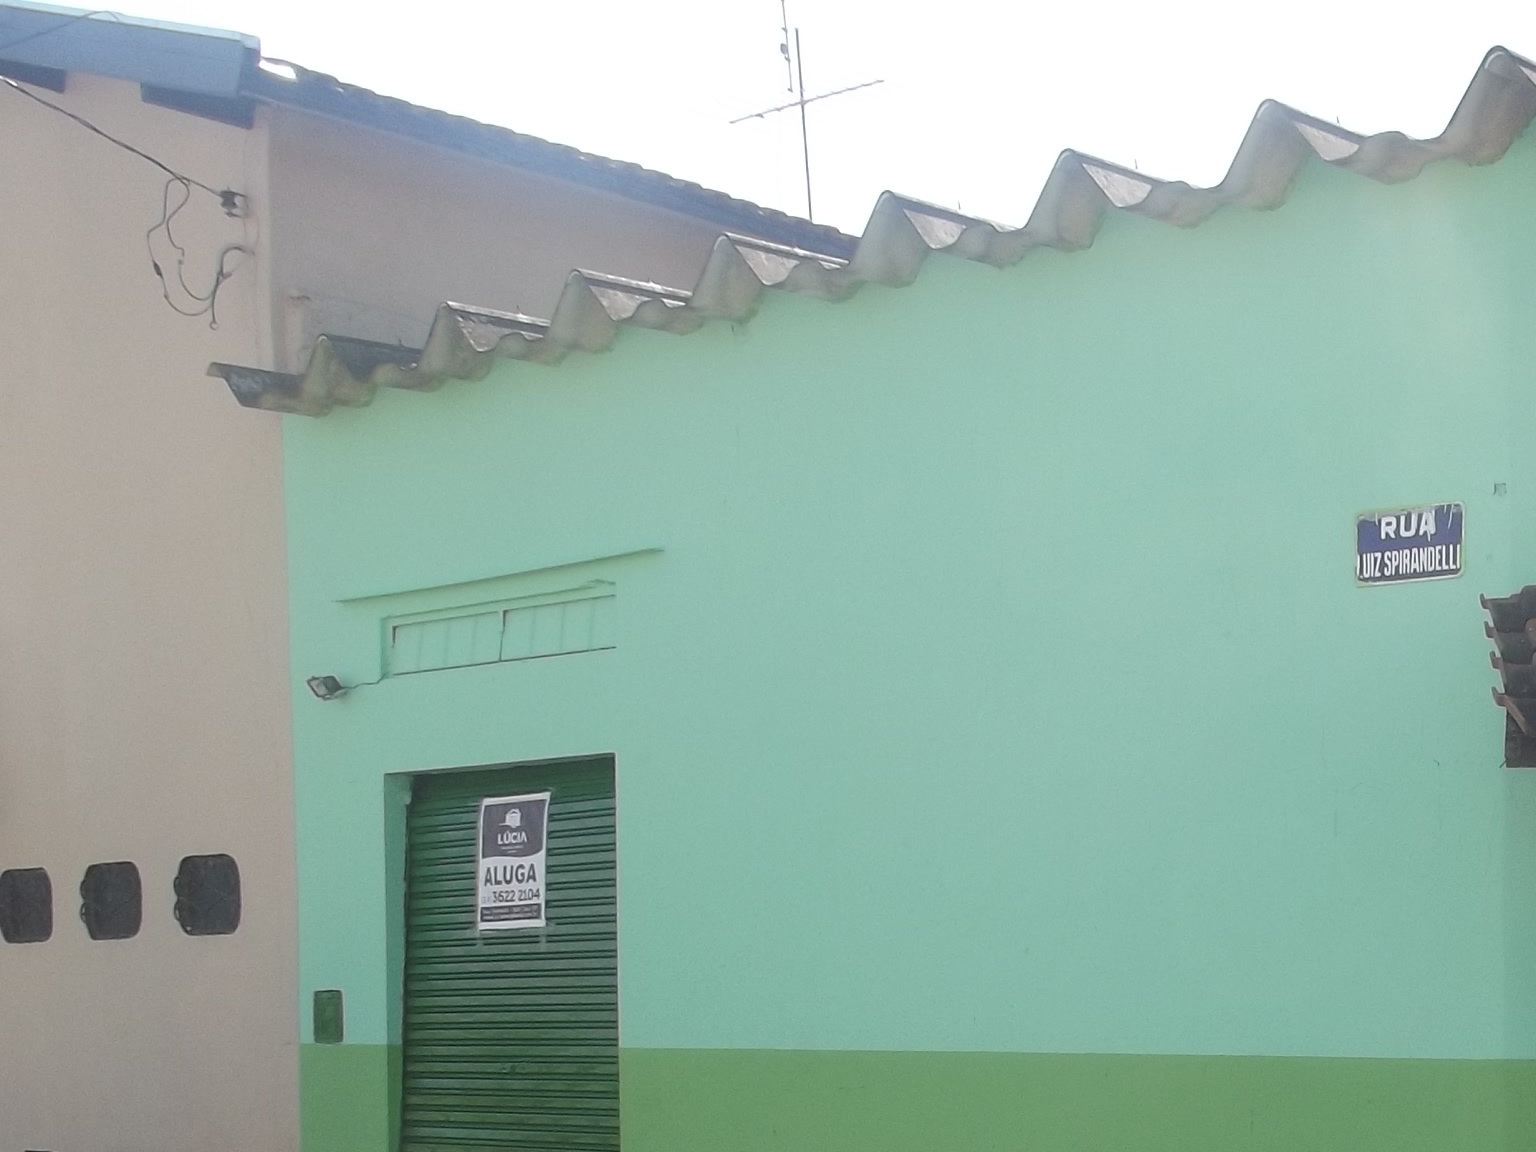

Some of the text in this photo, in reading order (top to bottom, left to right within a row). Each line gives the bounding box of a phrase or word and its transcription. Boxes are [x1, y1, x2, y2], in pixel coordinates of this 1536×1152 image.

[1380, 510, 1436, 540] RUA
[1384, 544, 1460, 576] SPIRANDELLI
[497, 831, 527, 845] LÚCIA
[484, 863, 537, 887] ALUGA
[492, 890, 516, 903] 3622
[518, 888, 540, 902] 2104
